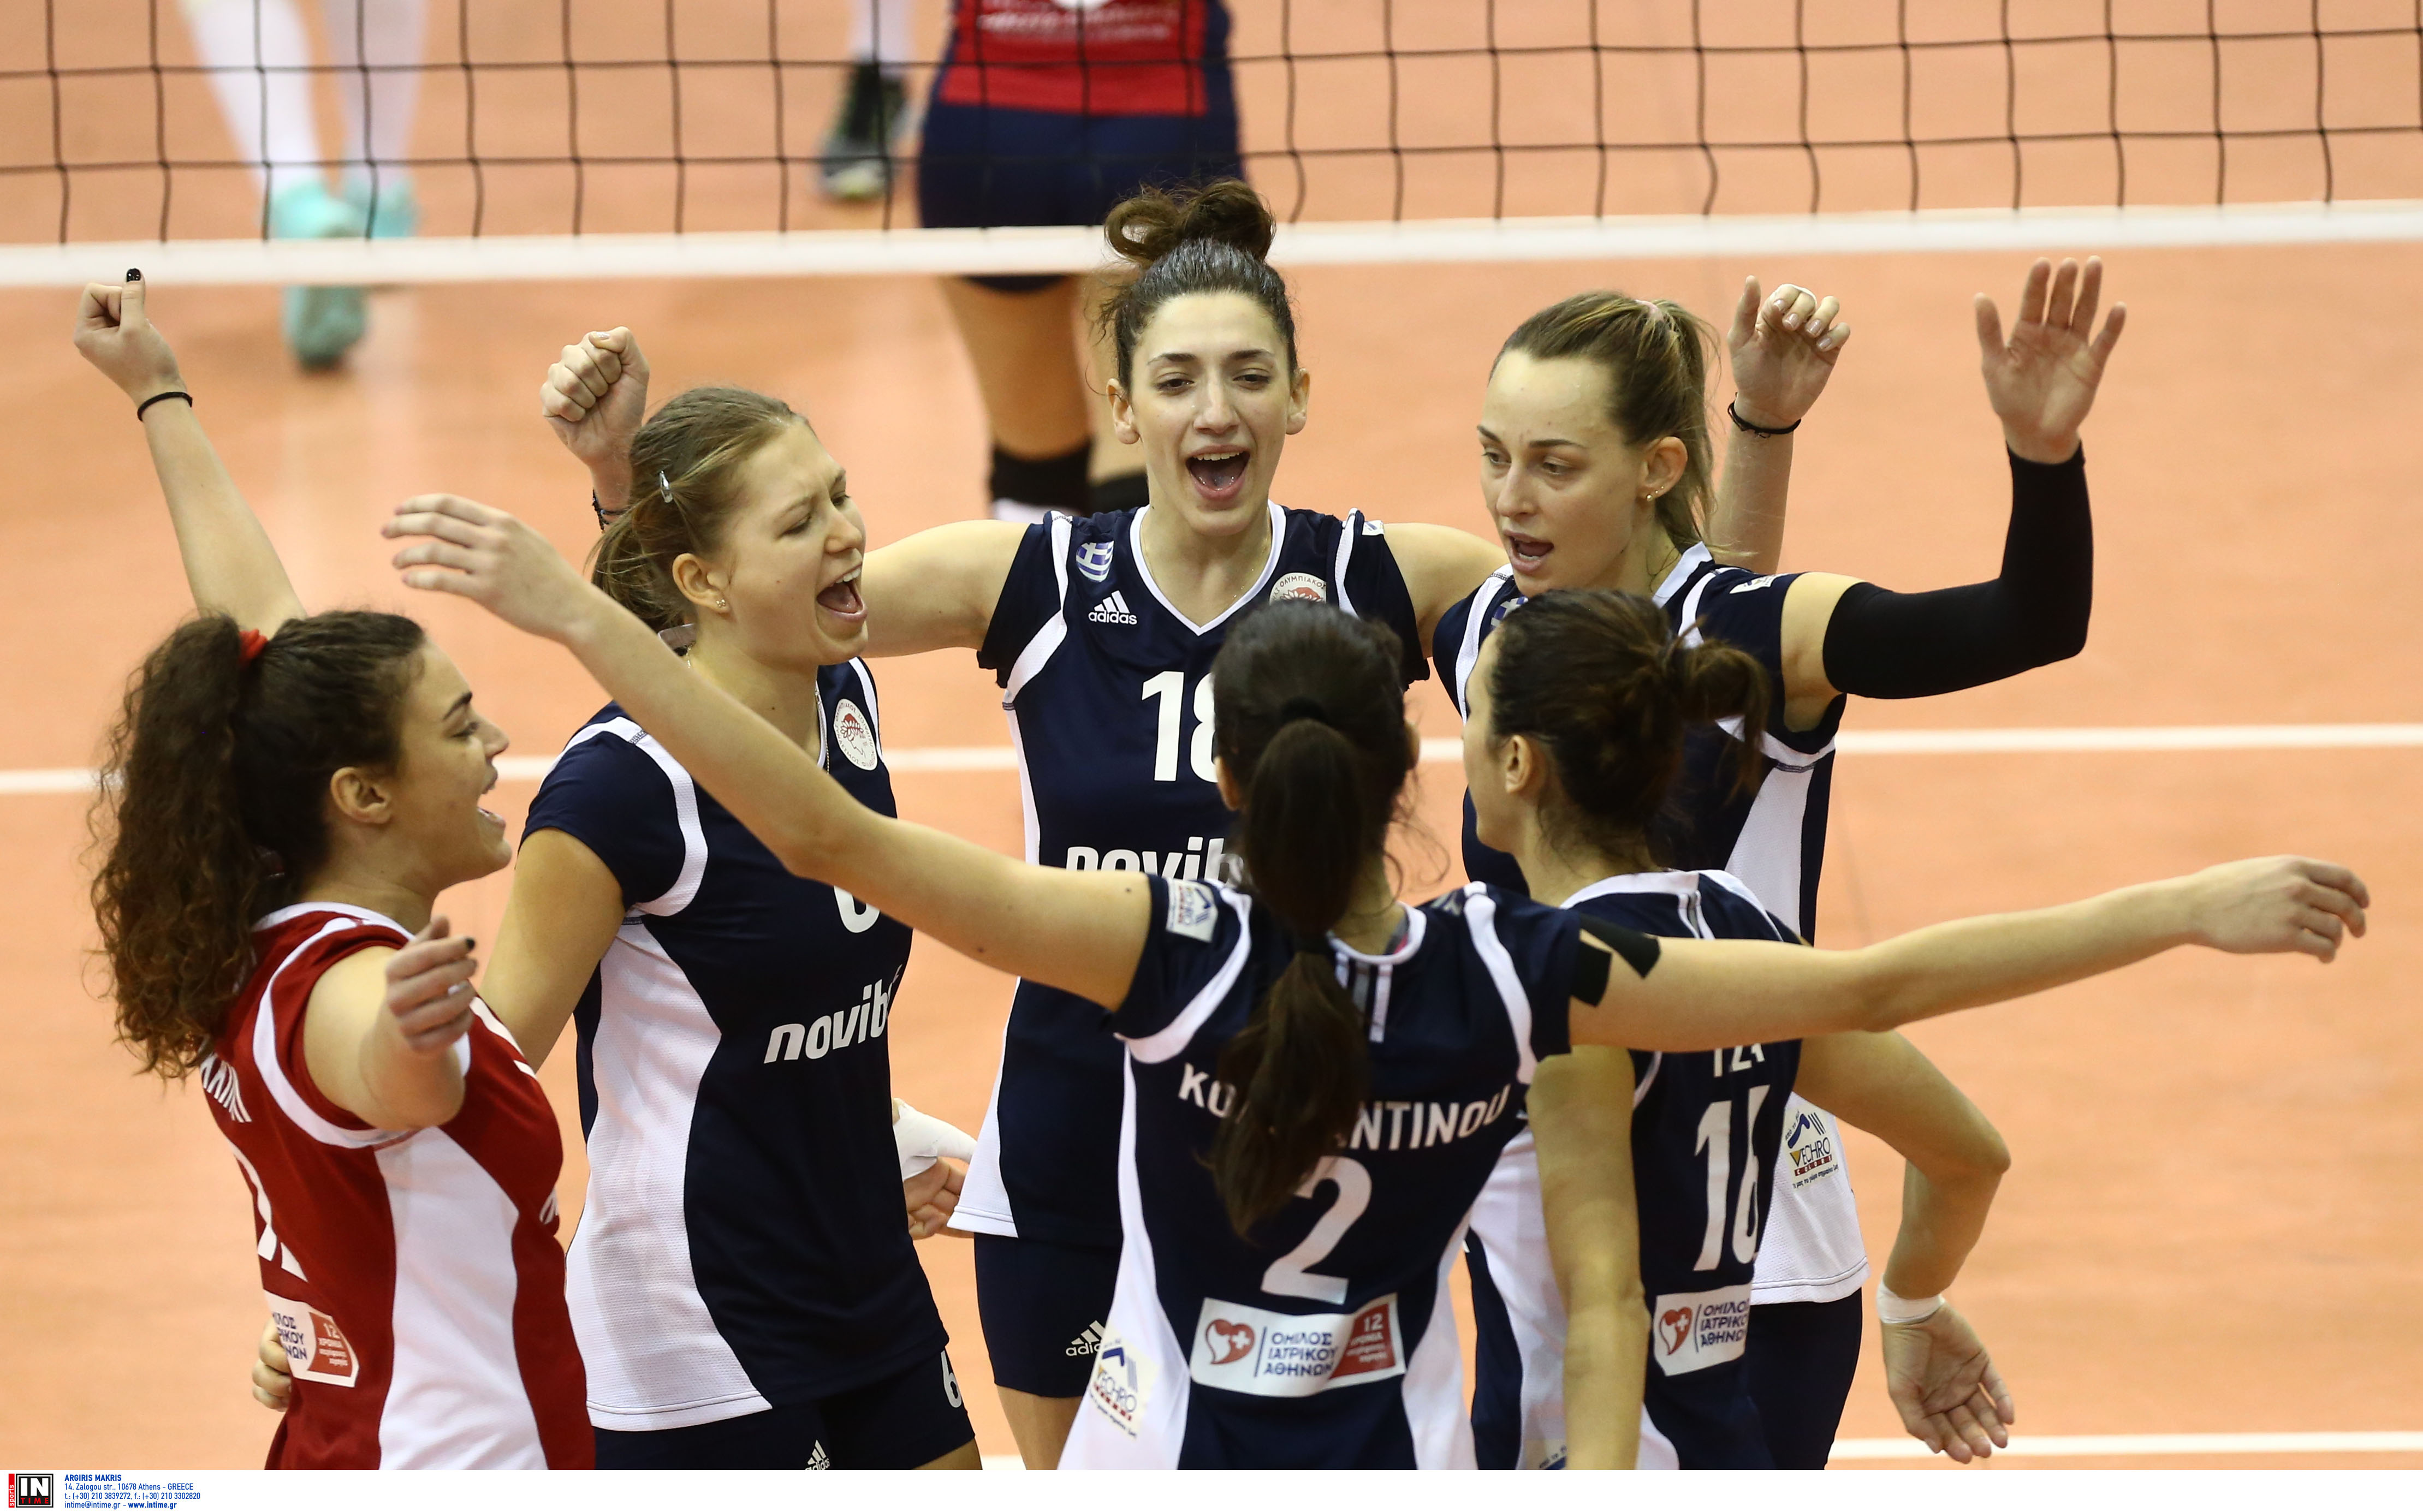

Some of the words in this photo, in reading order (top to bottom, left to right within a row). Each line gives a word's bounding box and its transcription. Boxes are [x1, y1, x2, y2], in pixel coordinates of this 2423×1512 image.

[1088, 610, 1138, 625] adidas
[1142, 670, 1220, 783] 18
[1066, 836, 1244, 880] novib
[764, 964, 902, 1064] novib
[1790, 1137, 1831, 1167] VECHRO
[1693, 1084, 1771, 1271] 16
[1261, 1156, 1373, 1305] 2
[1363, 1313, 1383, 1332] 12
[1703, 1299, 1749, 1317] ΟΜΙΛΟ
[1065, 1343, 1101, 1356] adi
[1701, 1329, 1747, 1348] ΑΘΗΝΩ
[940, 1350, 962, 1408] 6
